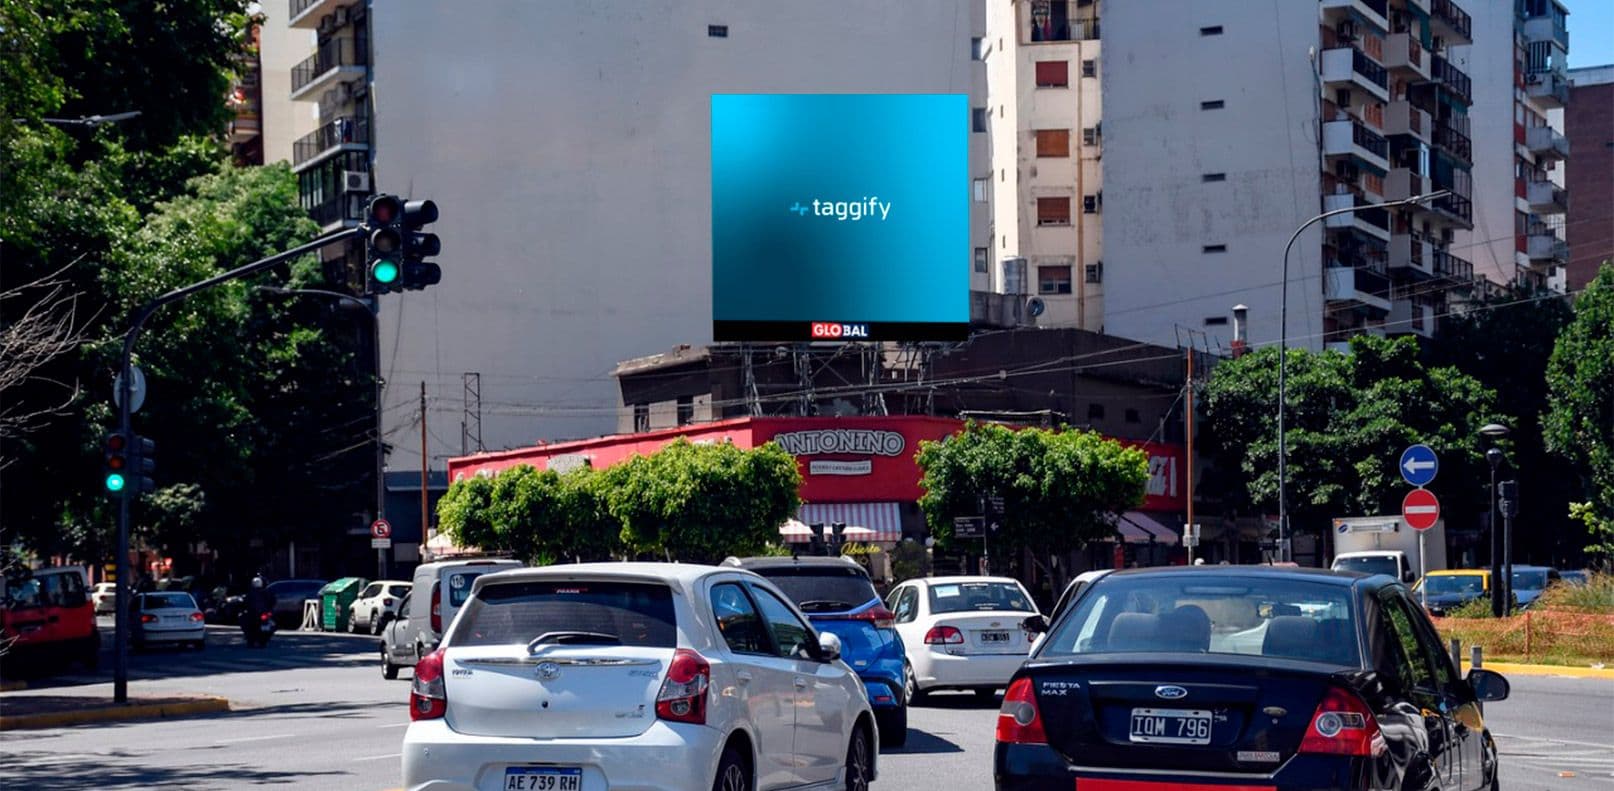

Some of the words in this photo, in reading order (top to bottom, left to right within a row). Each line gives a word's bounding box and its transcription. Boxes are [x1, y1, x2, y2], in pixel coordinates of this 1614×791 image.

[812, 196, 891, 221] taggify
[813, 323, 868, 337] GLOBAL
[1134, 716, 1166, 736] IQM
[1177, 717, 1209, 737] 796
[508, 775, 525, 790] AE
[530, 775, 555, 791] 739
[560, 775, 577, 791] RH
